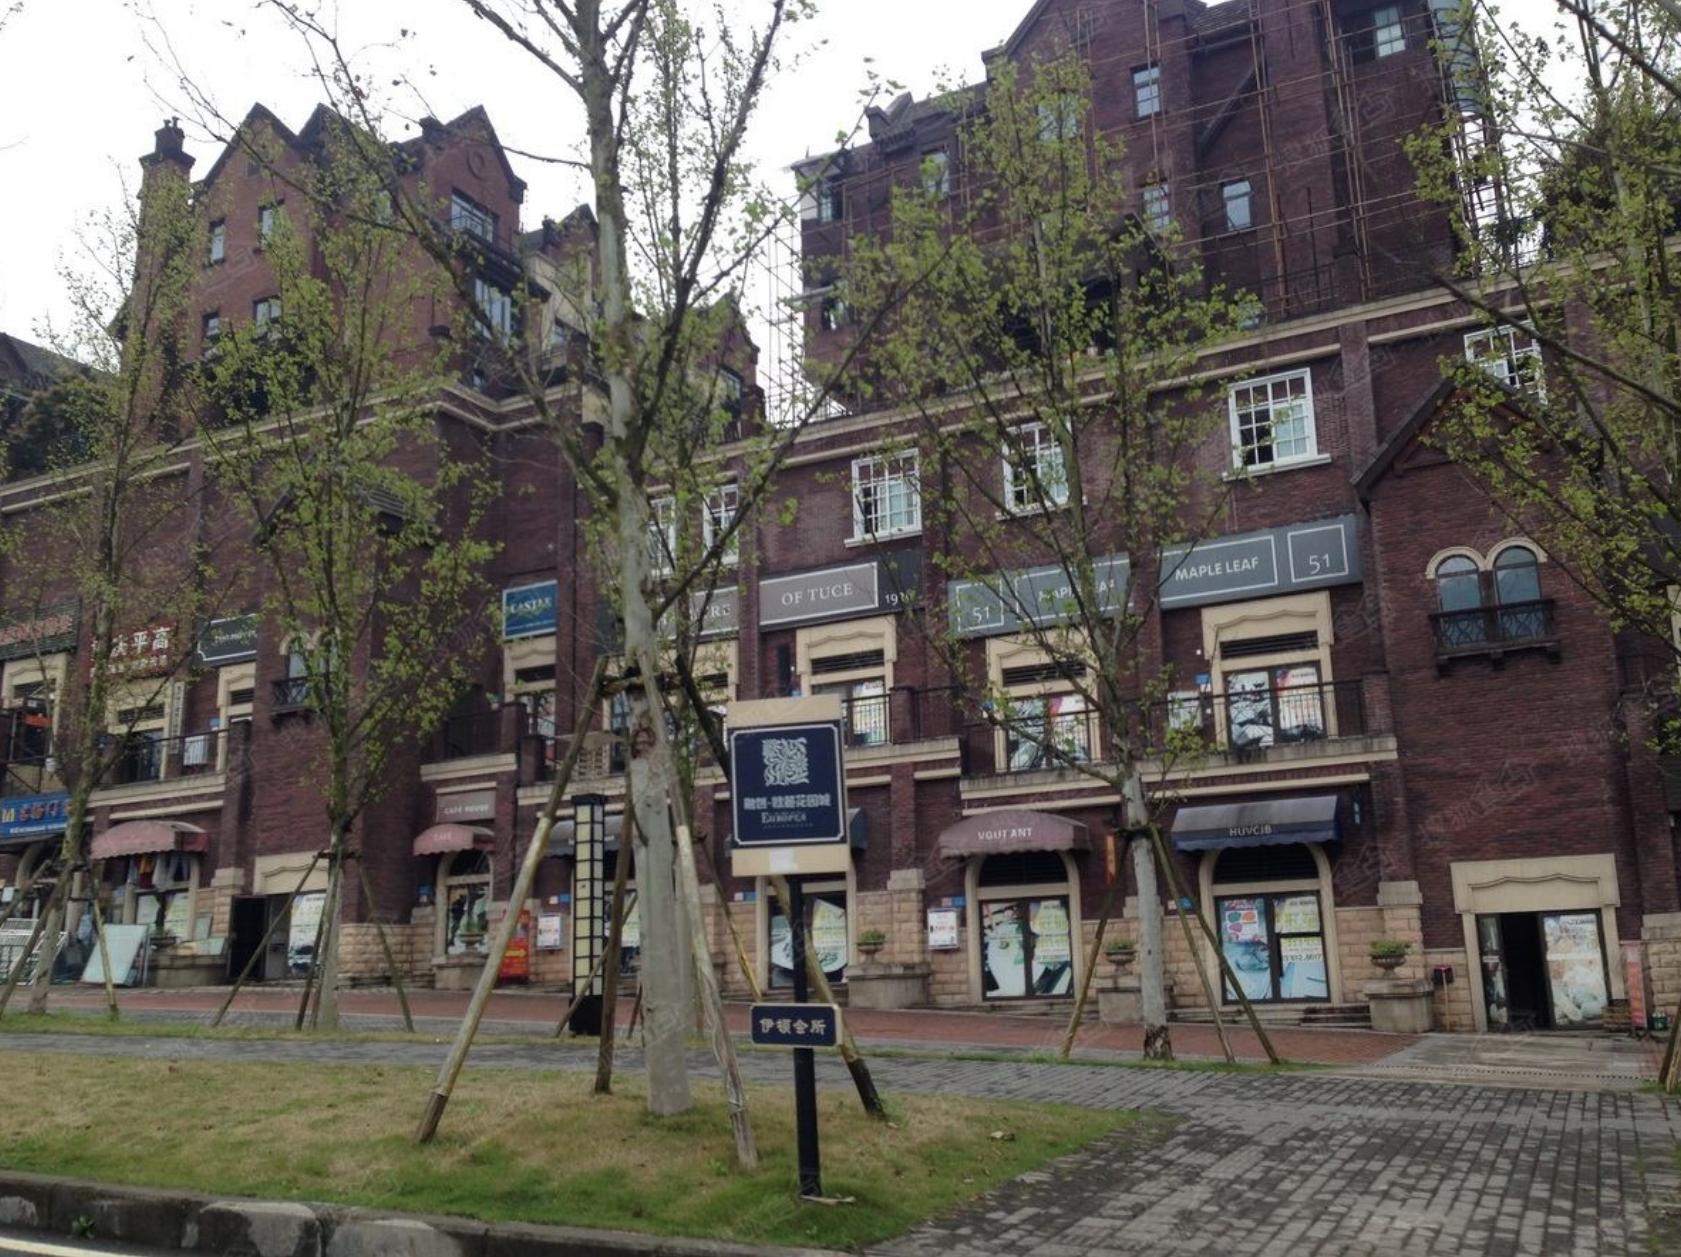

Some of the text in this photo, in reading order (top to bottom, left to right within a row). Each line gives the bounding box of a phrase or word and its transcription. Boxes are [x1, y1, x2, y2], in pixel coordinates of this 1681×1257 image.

[1175, 556, 1260, 582] MAPLE LEAF
[1308, 553, 1331, 575] 51
[781, 584, 854, 607] OF TUCE
[971, 606, 991, 624] 51
[760, 1018, 827, 1036] 伊顿会所
